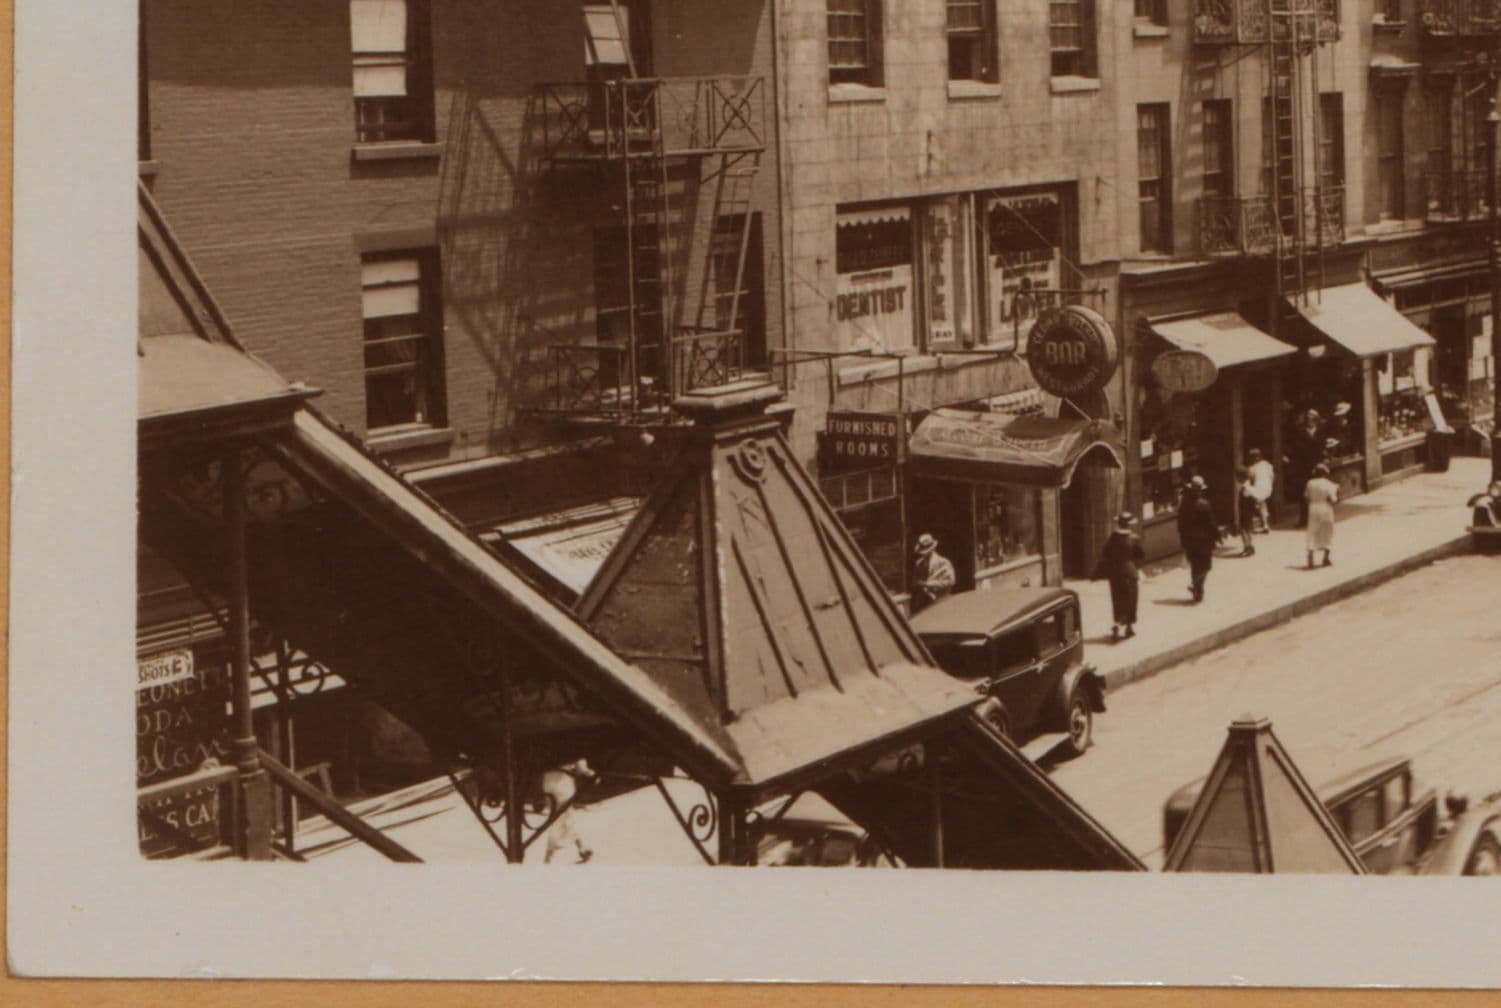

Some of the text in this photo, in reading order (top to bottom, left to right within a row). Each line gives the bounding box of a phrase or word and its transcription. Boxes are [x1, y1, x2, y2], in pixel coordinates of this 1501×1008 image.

[837, 287, 906, 323] DENTIST
[828, 417, 896, 437] FURNISHED
[835, 440, 890, 458] ROOMS
